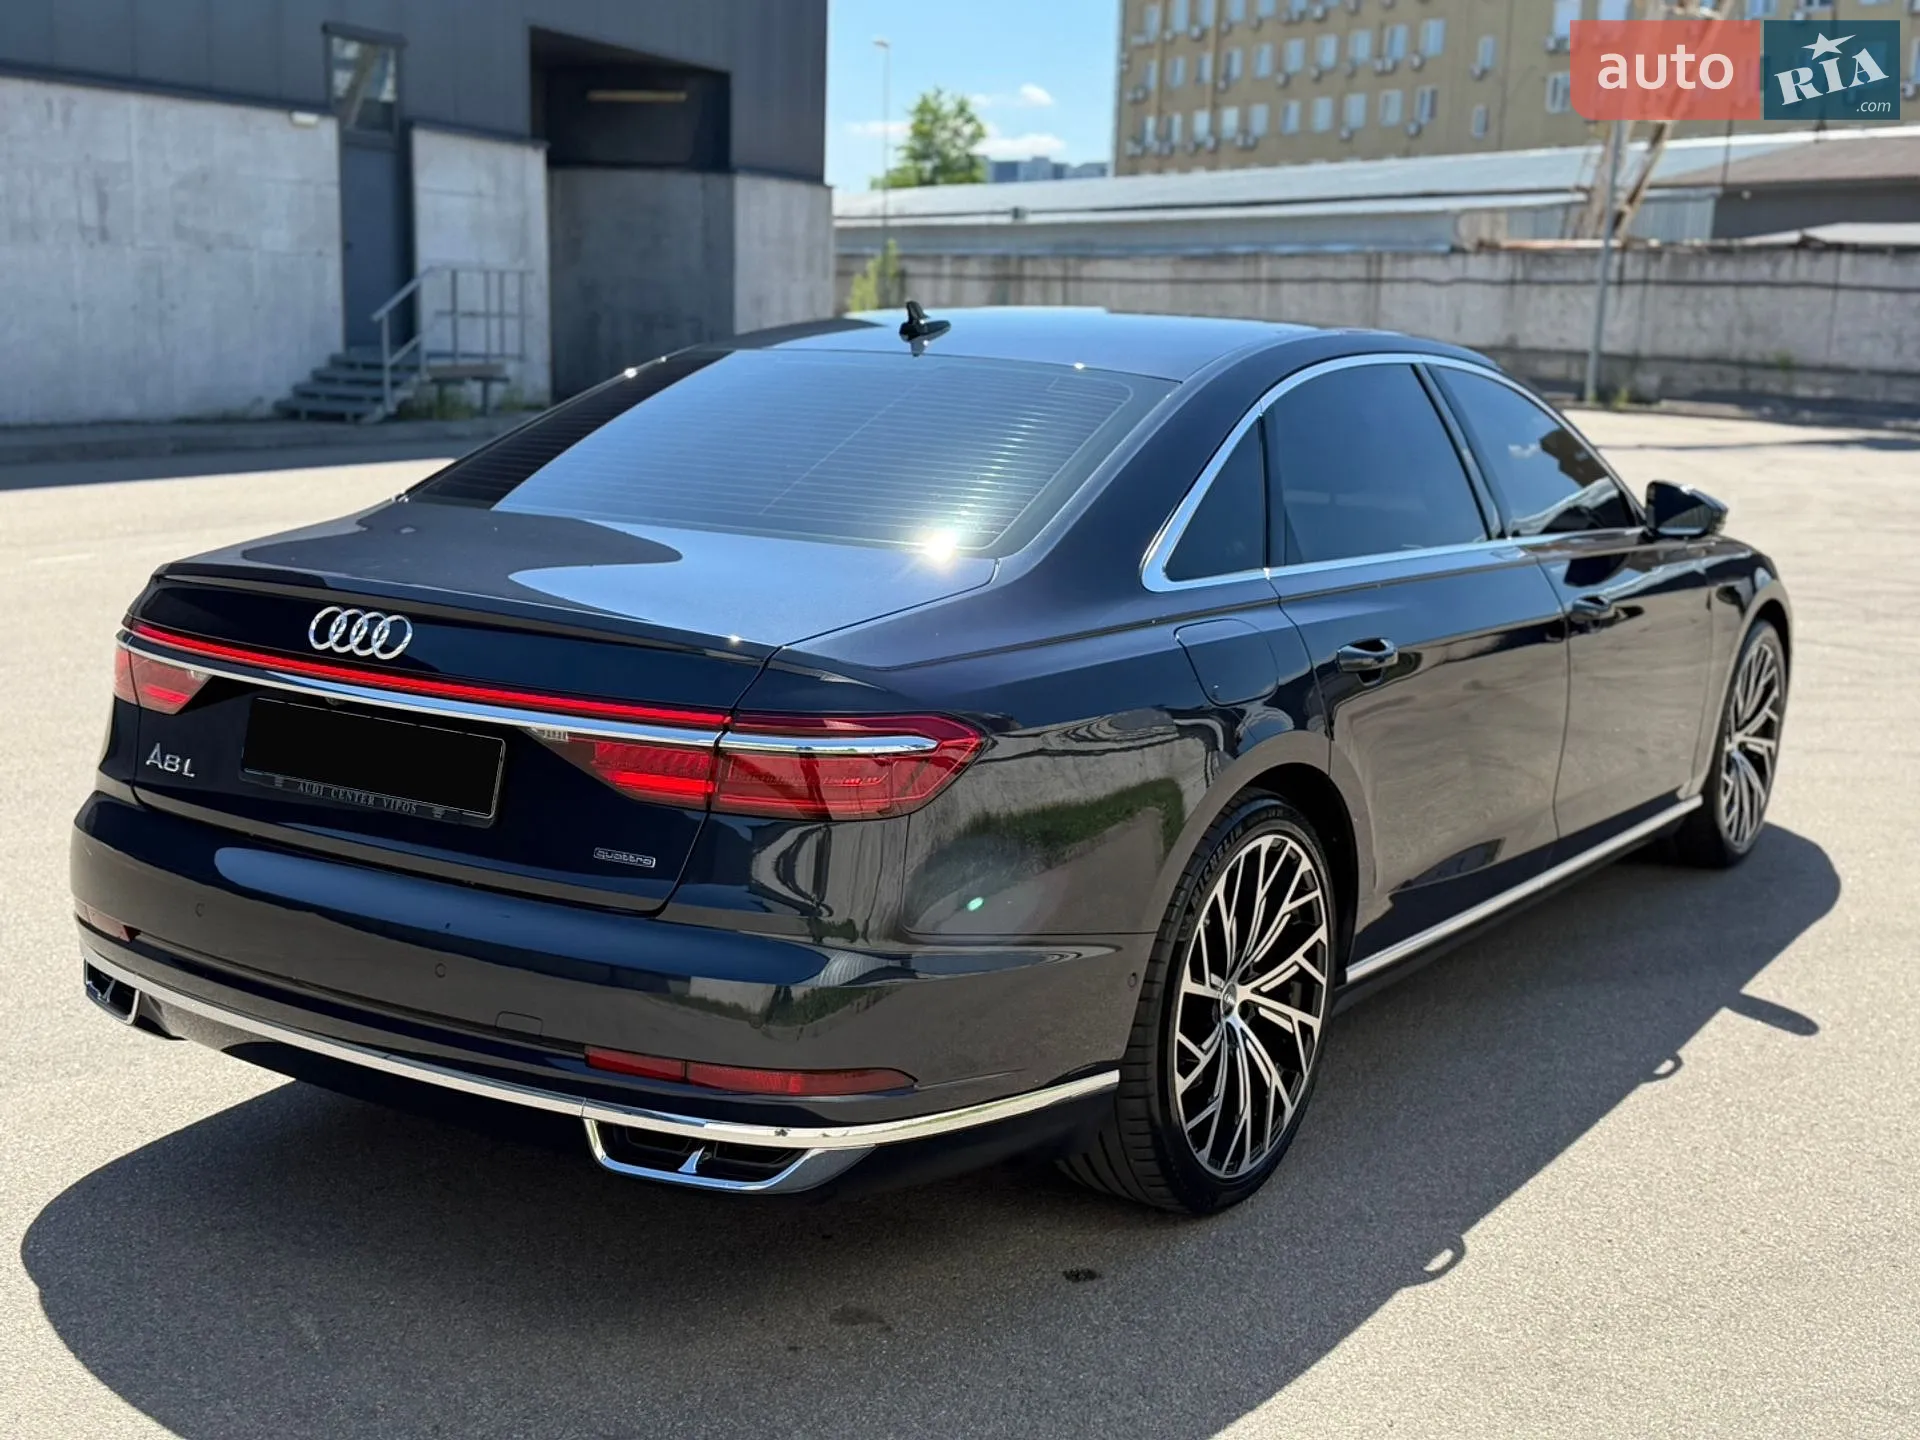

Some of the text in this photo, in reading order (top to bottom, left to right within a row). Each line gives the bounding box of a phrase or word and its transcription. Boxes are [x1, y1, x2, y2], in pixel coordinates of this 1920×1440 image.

[297, 781, 325, 797] AUDI
[330, 786, 375, 806] CENTER
[595, 849, 653, 866] quattro
